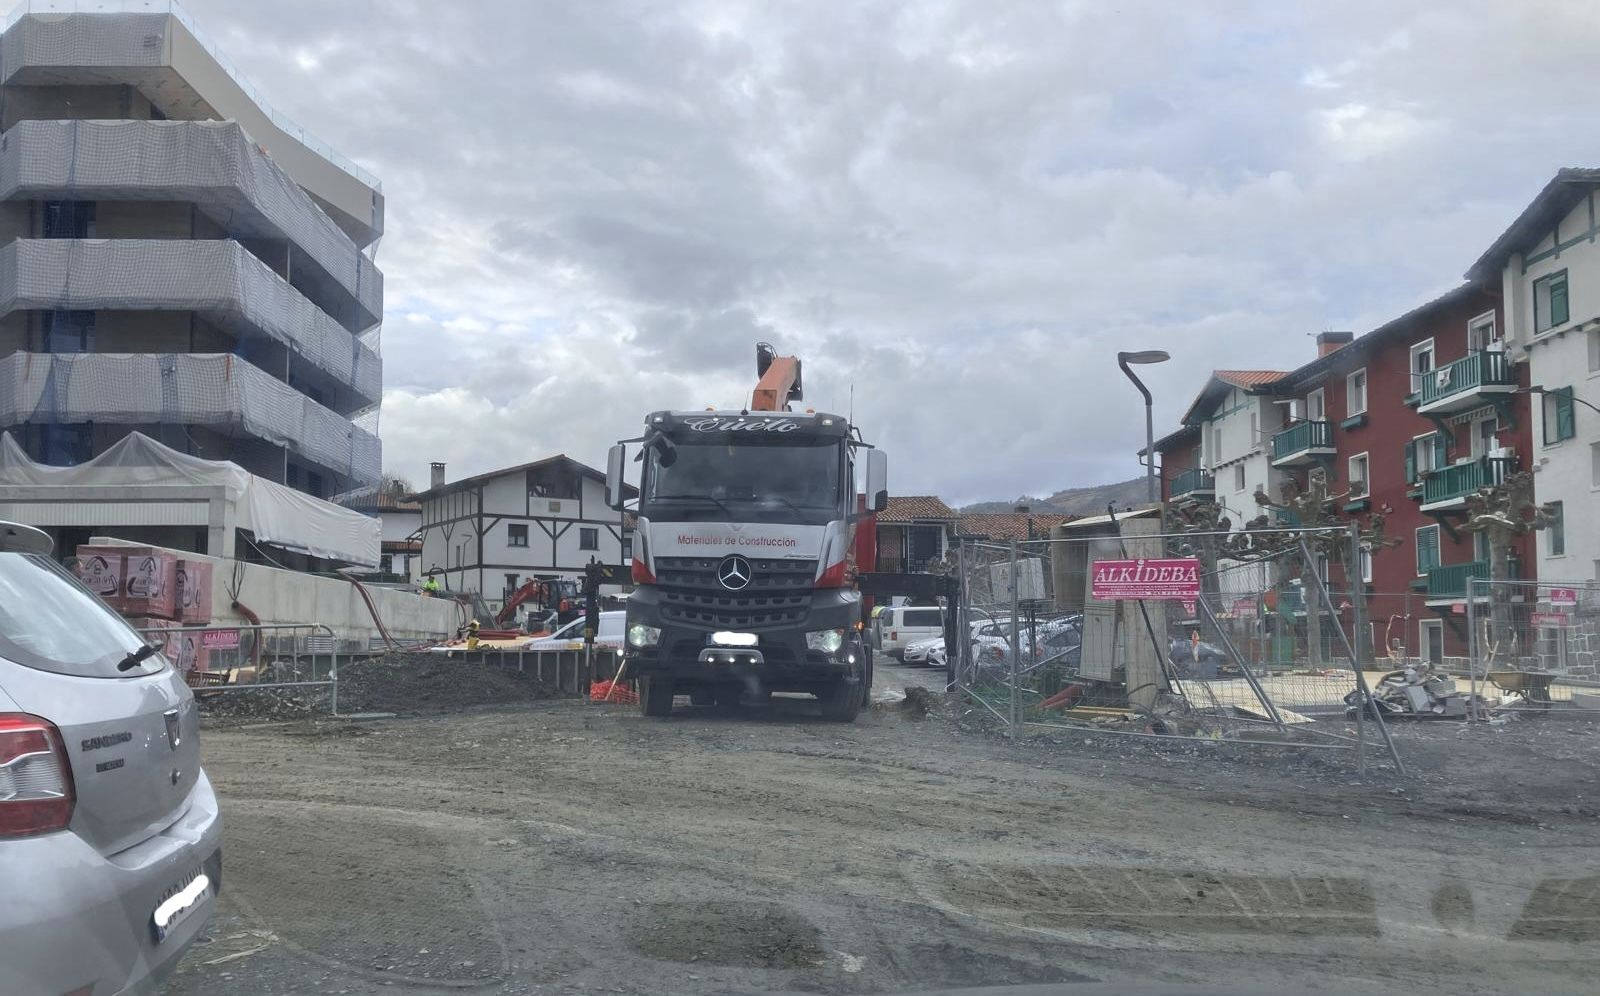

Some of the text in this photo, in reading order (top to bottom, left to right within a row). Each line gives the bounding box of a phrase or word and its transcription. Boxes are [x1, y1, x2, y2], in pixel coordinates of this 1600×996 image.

[677, 535, 796, 547] Materiales de Construcción
